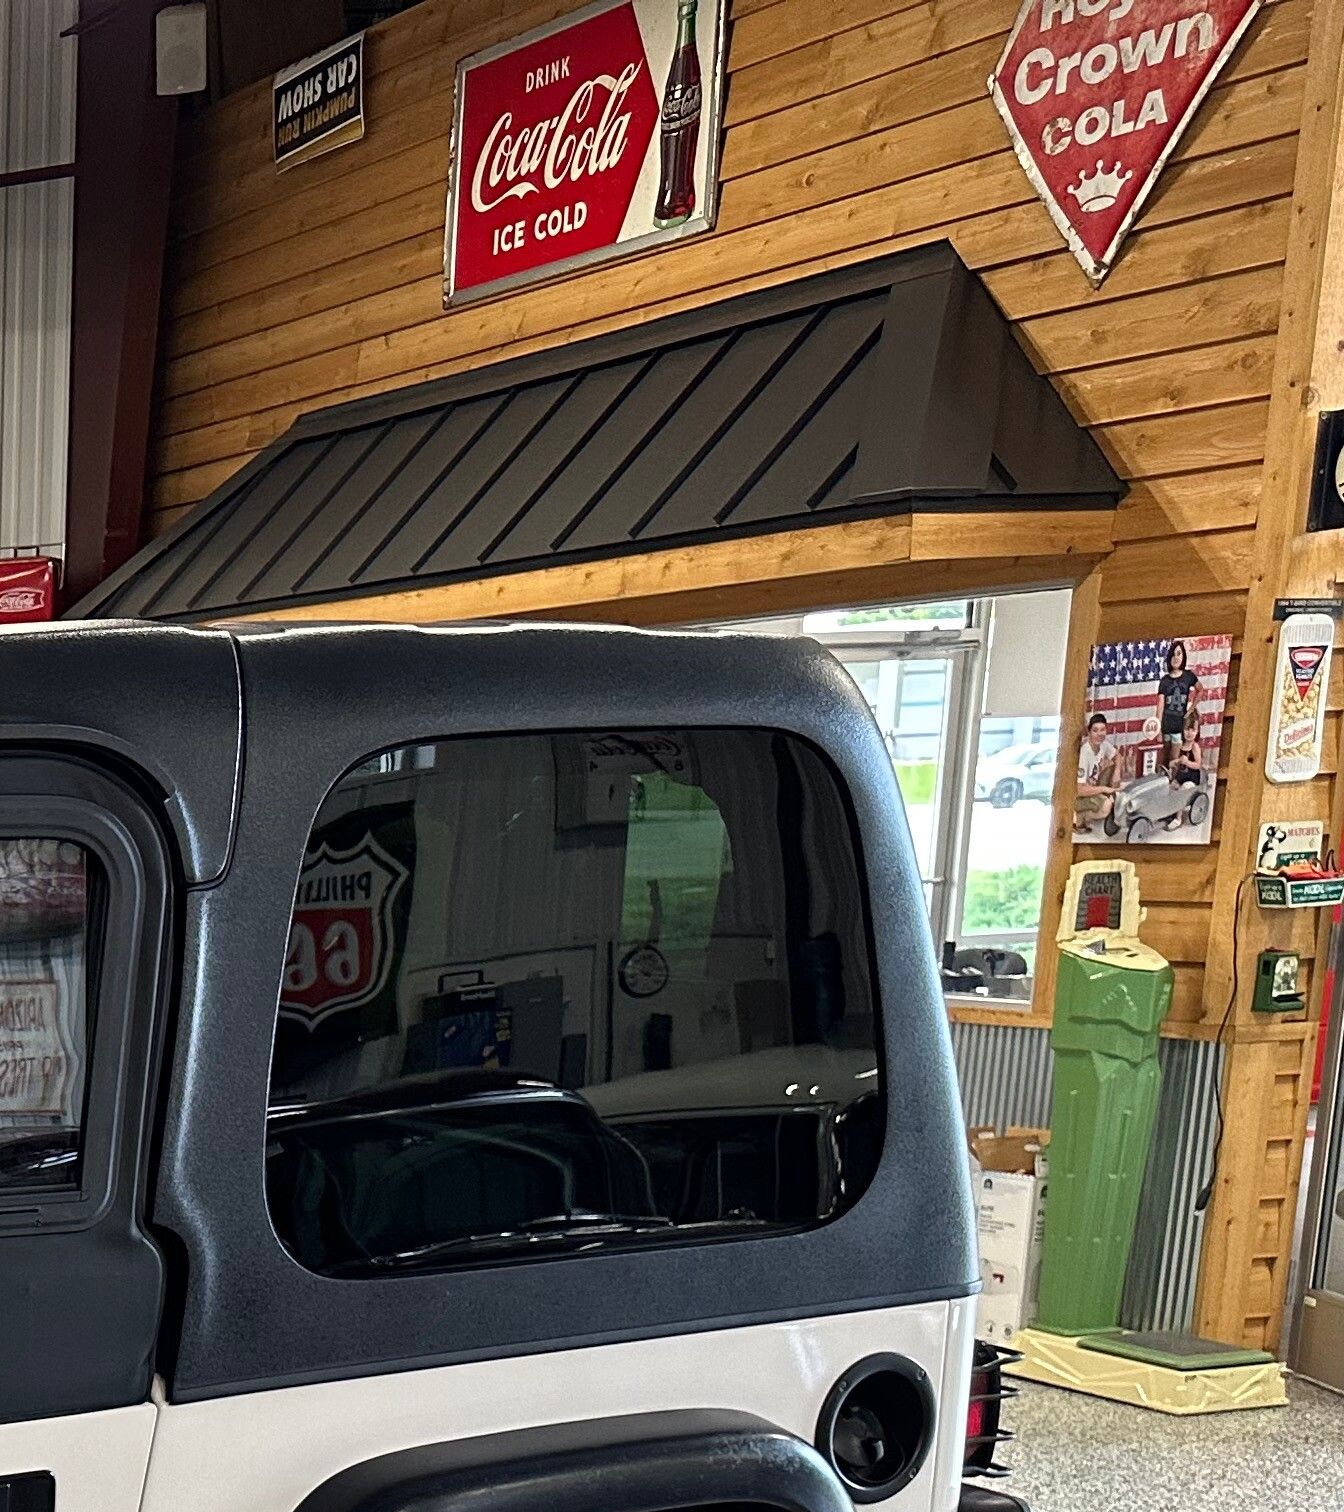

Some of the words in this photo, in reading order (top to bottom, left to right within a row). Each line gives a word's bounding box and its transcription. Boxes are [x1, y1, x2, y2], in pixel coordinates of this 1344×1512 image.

[326, 53, 358, 94] CAR
[525, 55, 571, 93] DRINK
[1014, 11, 1215, 106] Crown
[277, 72, 324, 123] SHOW
[303, 86, 356, 134] PUMPKIN
[1040, 89, 1170, 156] COLA
[472, 57, 643, 213] Coca-Cola
[492, 220, 525, 256] ICE
[534, 201, 588, 243] COLD
